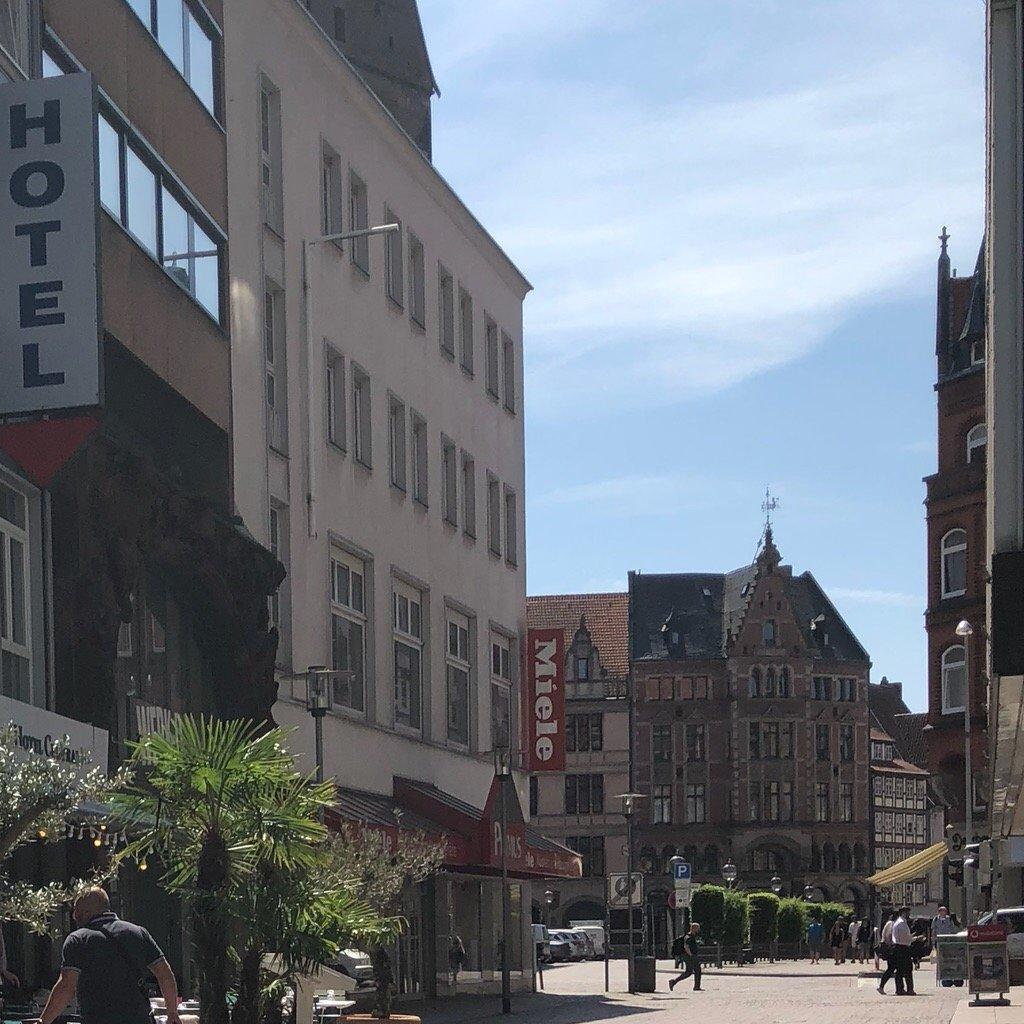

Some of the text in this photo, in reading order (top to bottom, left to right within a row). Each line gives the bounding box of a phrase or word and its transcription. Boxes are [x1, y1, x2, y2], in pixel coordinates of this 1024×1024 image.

[9, 98, 66, 389] HOTEL
[534, 638, 558, 762] Miele
[678, 865, 687, 877] P
